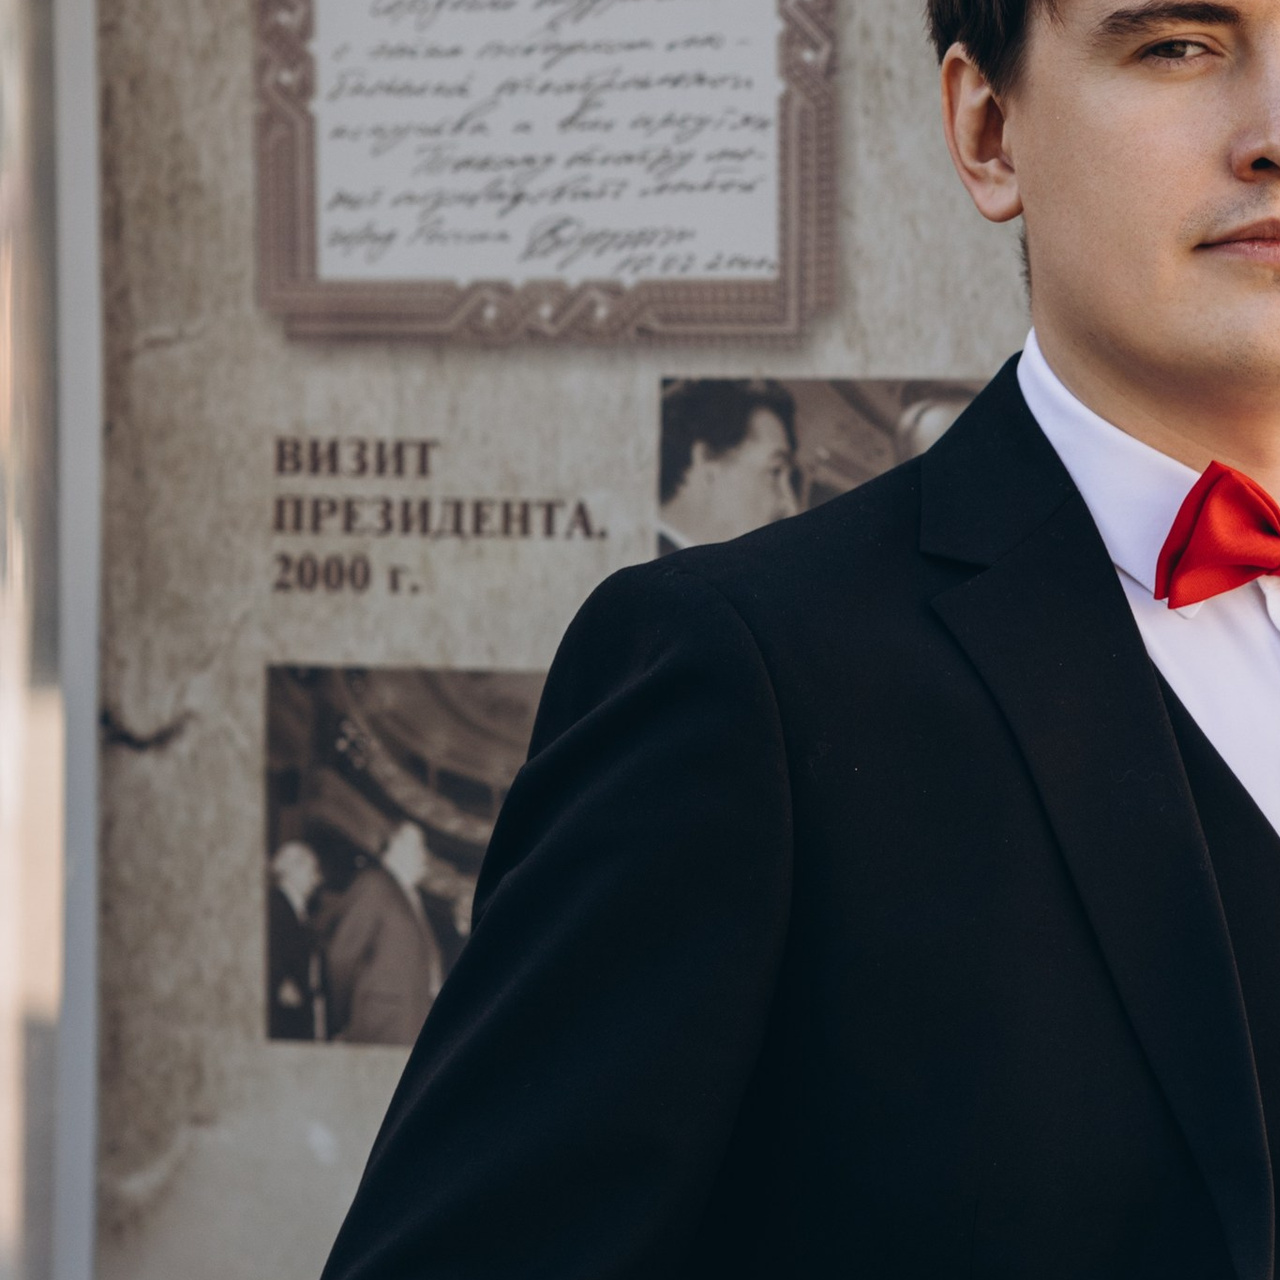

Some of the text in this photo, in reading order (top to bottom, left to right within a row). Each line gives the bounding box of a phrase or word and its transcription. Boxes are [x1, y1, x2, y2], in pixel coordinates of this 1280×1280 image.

[275, 438, 440, 477] ВИЗИТ
[272, 495, 608, 540] ПРЕЗИДЕНТА.
[272, 553, 422, 595] 2000 г.
